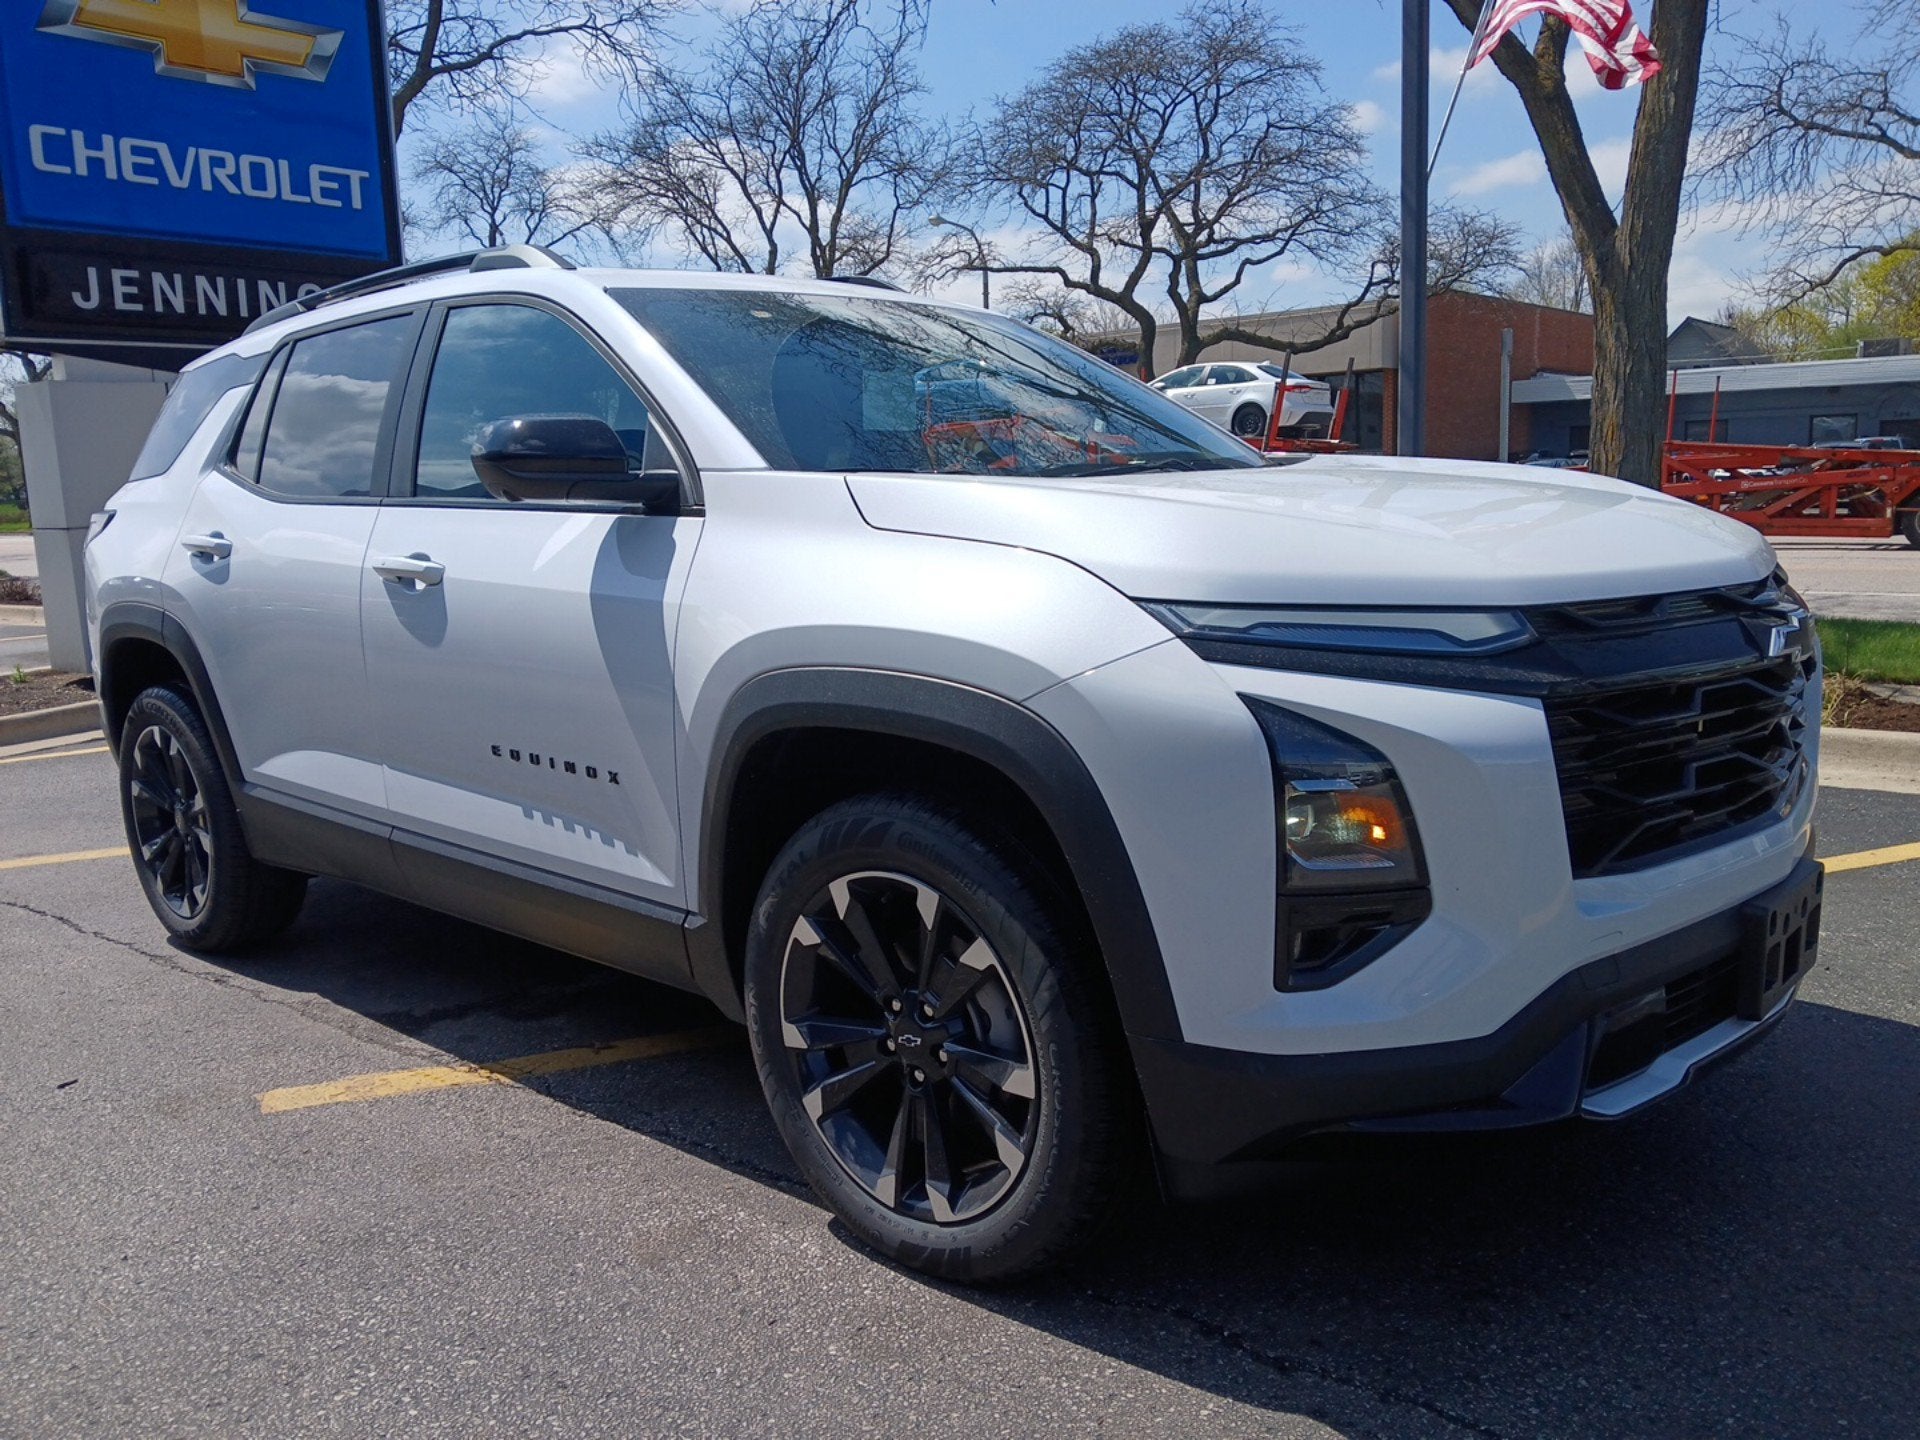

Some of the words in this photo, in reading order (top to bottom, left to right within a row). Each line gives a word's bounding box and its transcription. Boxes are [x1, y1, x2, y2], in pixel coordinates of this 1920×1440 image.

[29, 124, 370, 210] CHEVROLET
[491, 744, 619, 785] EQUINOX
[897, 831, 982, 895] Continental
